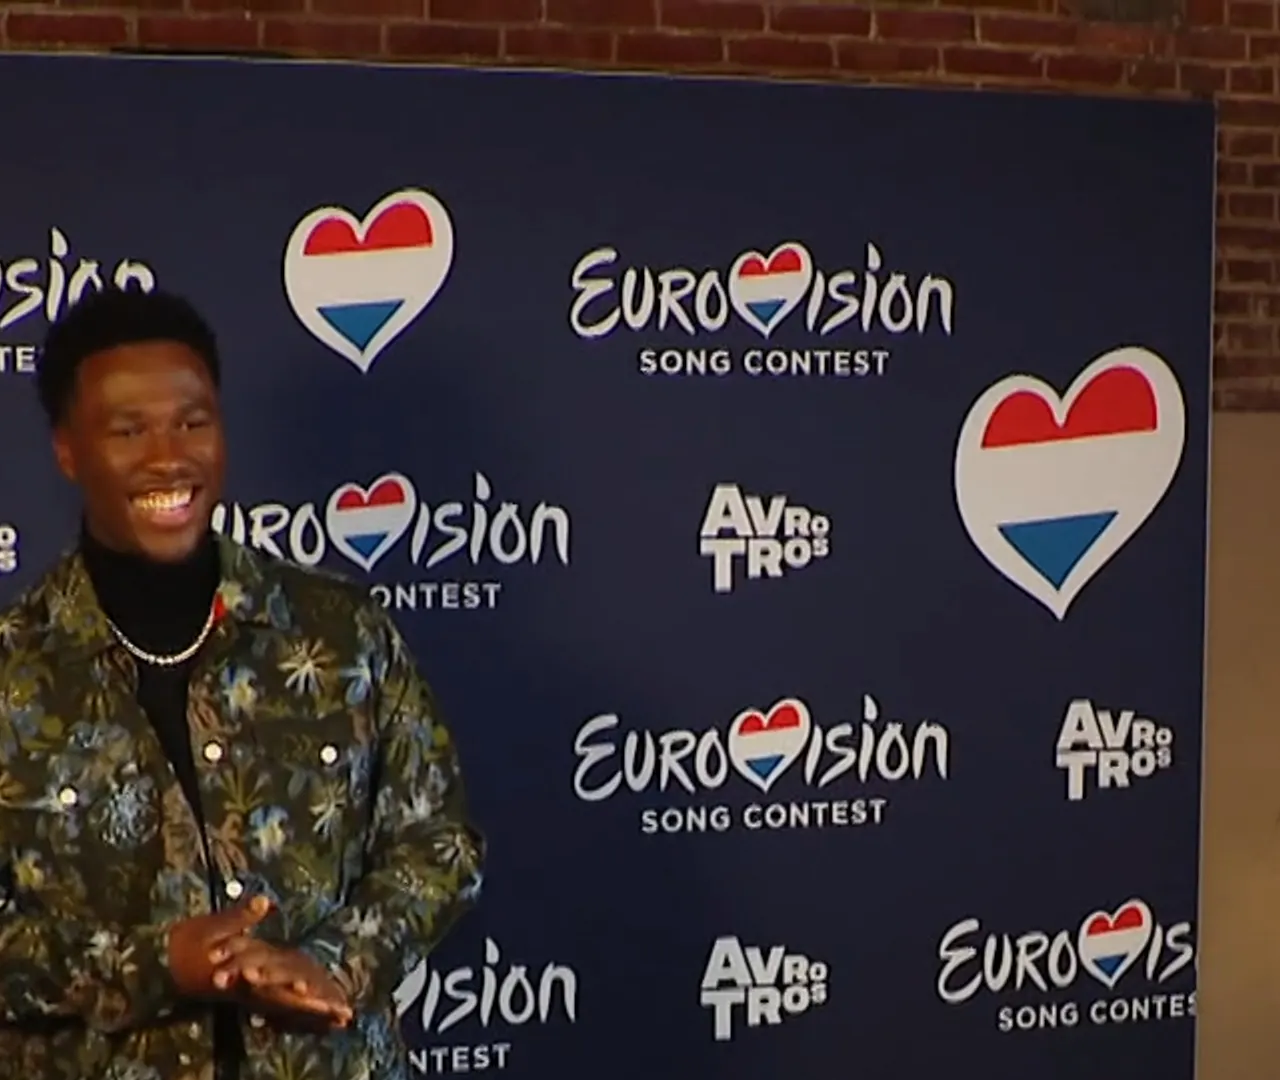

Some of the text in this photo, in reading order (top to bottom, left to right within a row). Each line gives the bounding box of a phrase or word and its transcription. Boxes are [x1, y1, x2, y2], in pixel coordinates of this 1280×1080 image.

[640, 349, 889, 376] SONG CONTEST
[370, 582, 502, 610] ONTEST
[642, 799, 886, 833] SONG CONTEST
[998, 1003, 1078, 1032] SONG
[408, 1042, 511, 1075] NTEST
